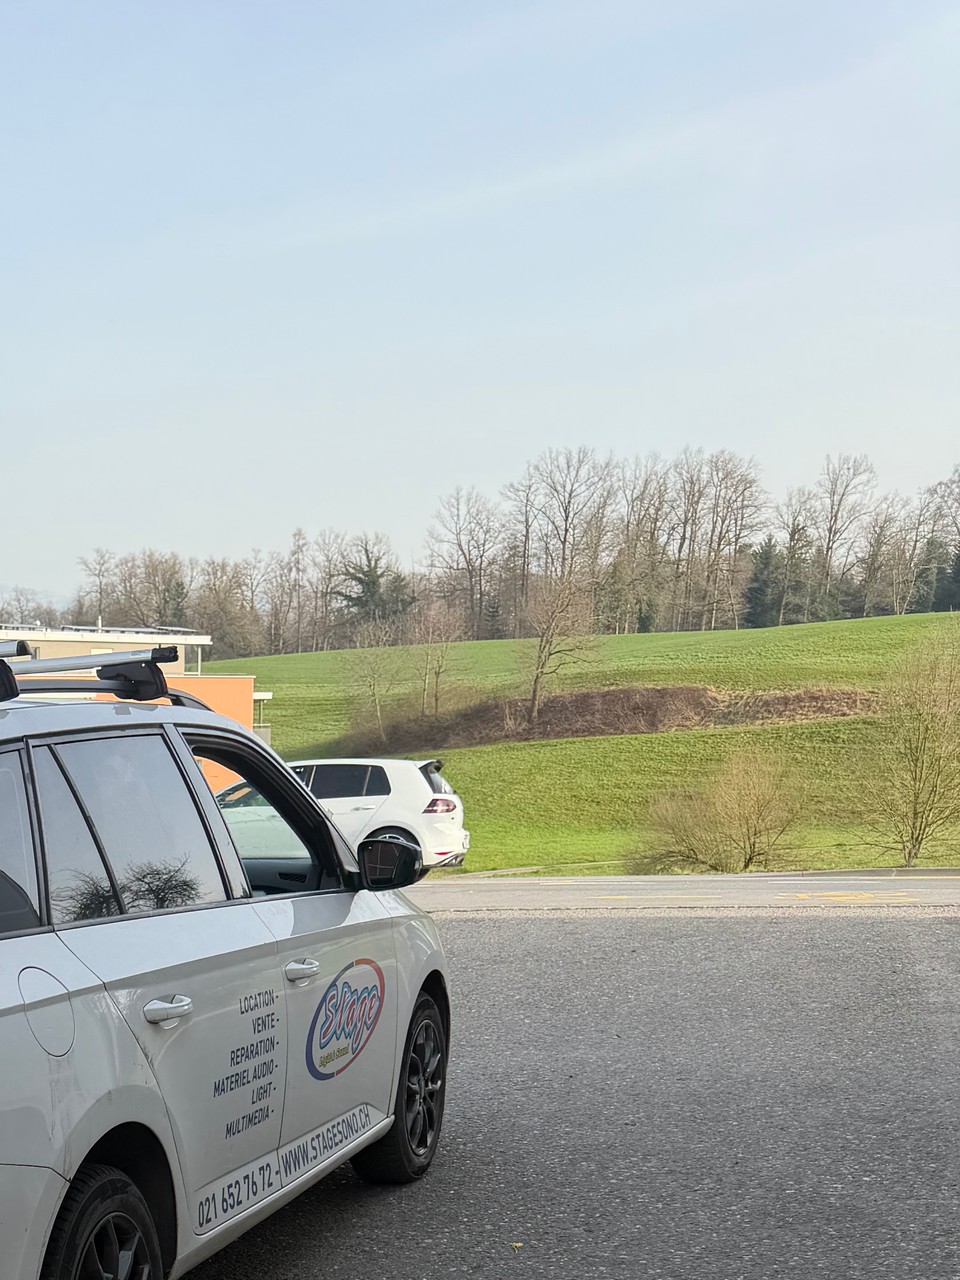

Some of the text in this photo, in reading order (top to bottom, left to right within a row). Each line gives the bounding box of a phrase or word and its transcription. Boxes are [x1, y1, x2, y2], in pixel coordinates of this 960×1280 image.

[240, 989, 275, 1014] LOCATION
[252, 1012, 275, 1035] VENTE
[319, 981, 380, 1055] Stage
[230, 1036, 275, 1067] REPARATION
[213, 1068, 251, 1098] MATERIEL
[252, 1059, 274, 1082] AUDIO
[251, 1082, 273, 1105] LIGHT
[225, 1105, 270, 1139] MULTIMEDIA
[198, 1193, 218, 1228] 021
[221, 1180, 242, 1214] 652
[243, 1171, 258, 1201] 76
[259, 1162, 273, 1191] 72
[281, 1104, 372, 1178] WWW.STAGESONO.CH
